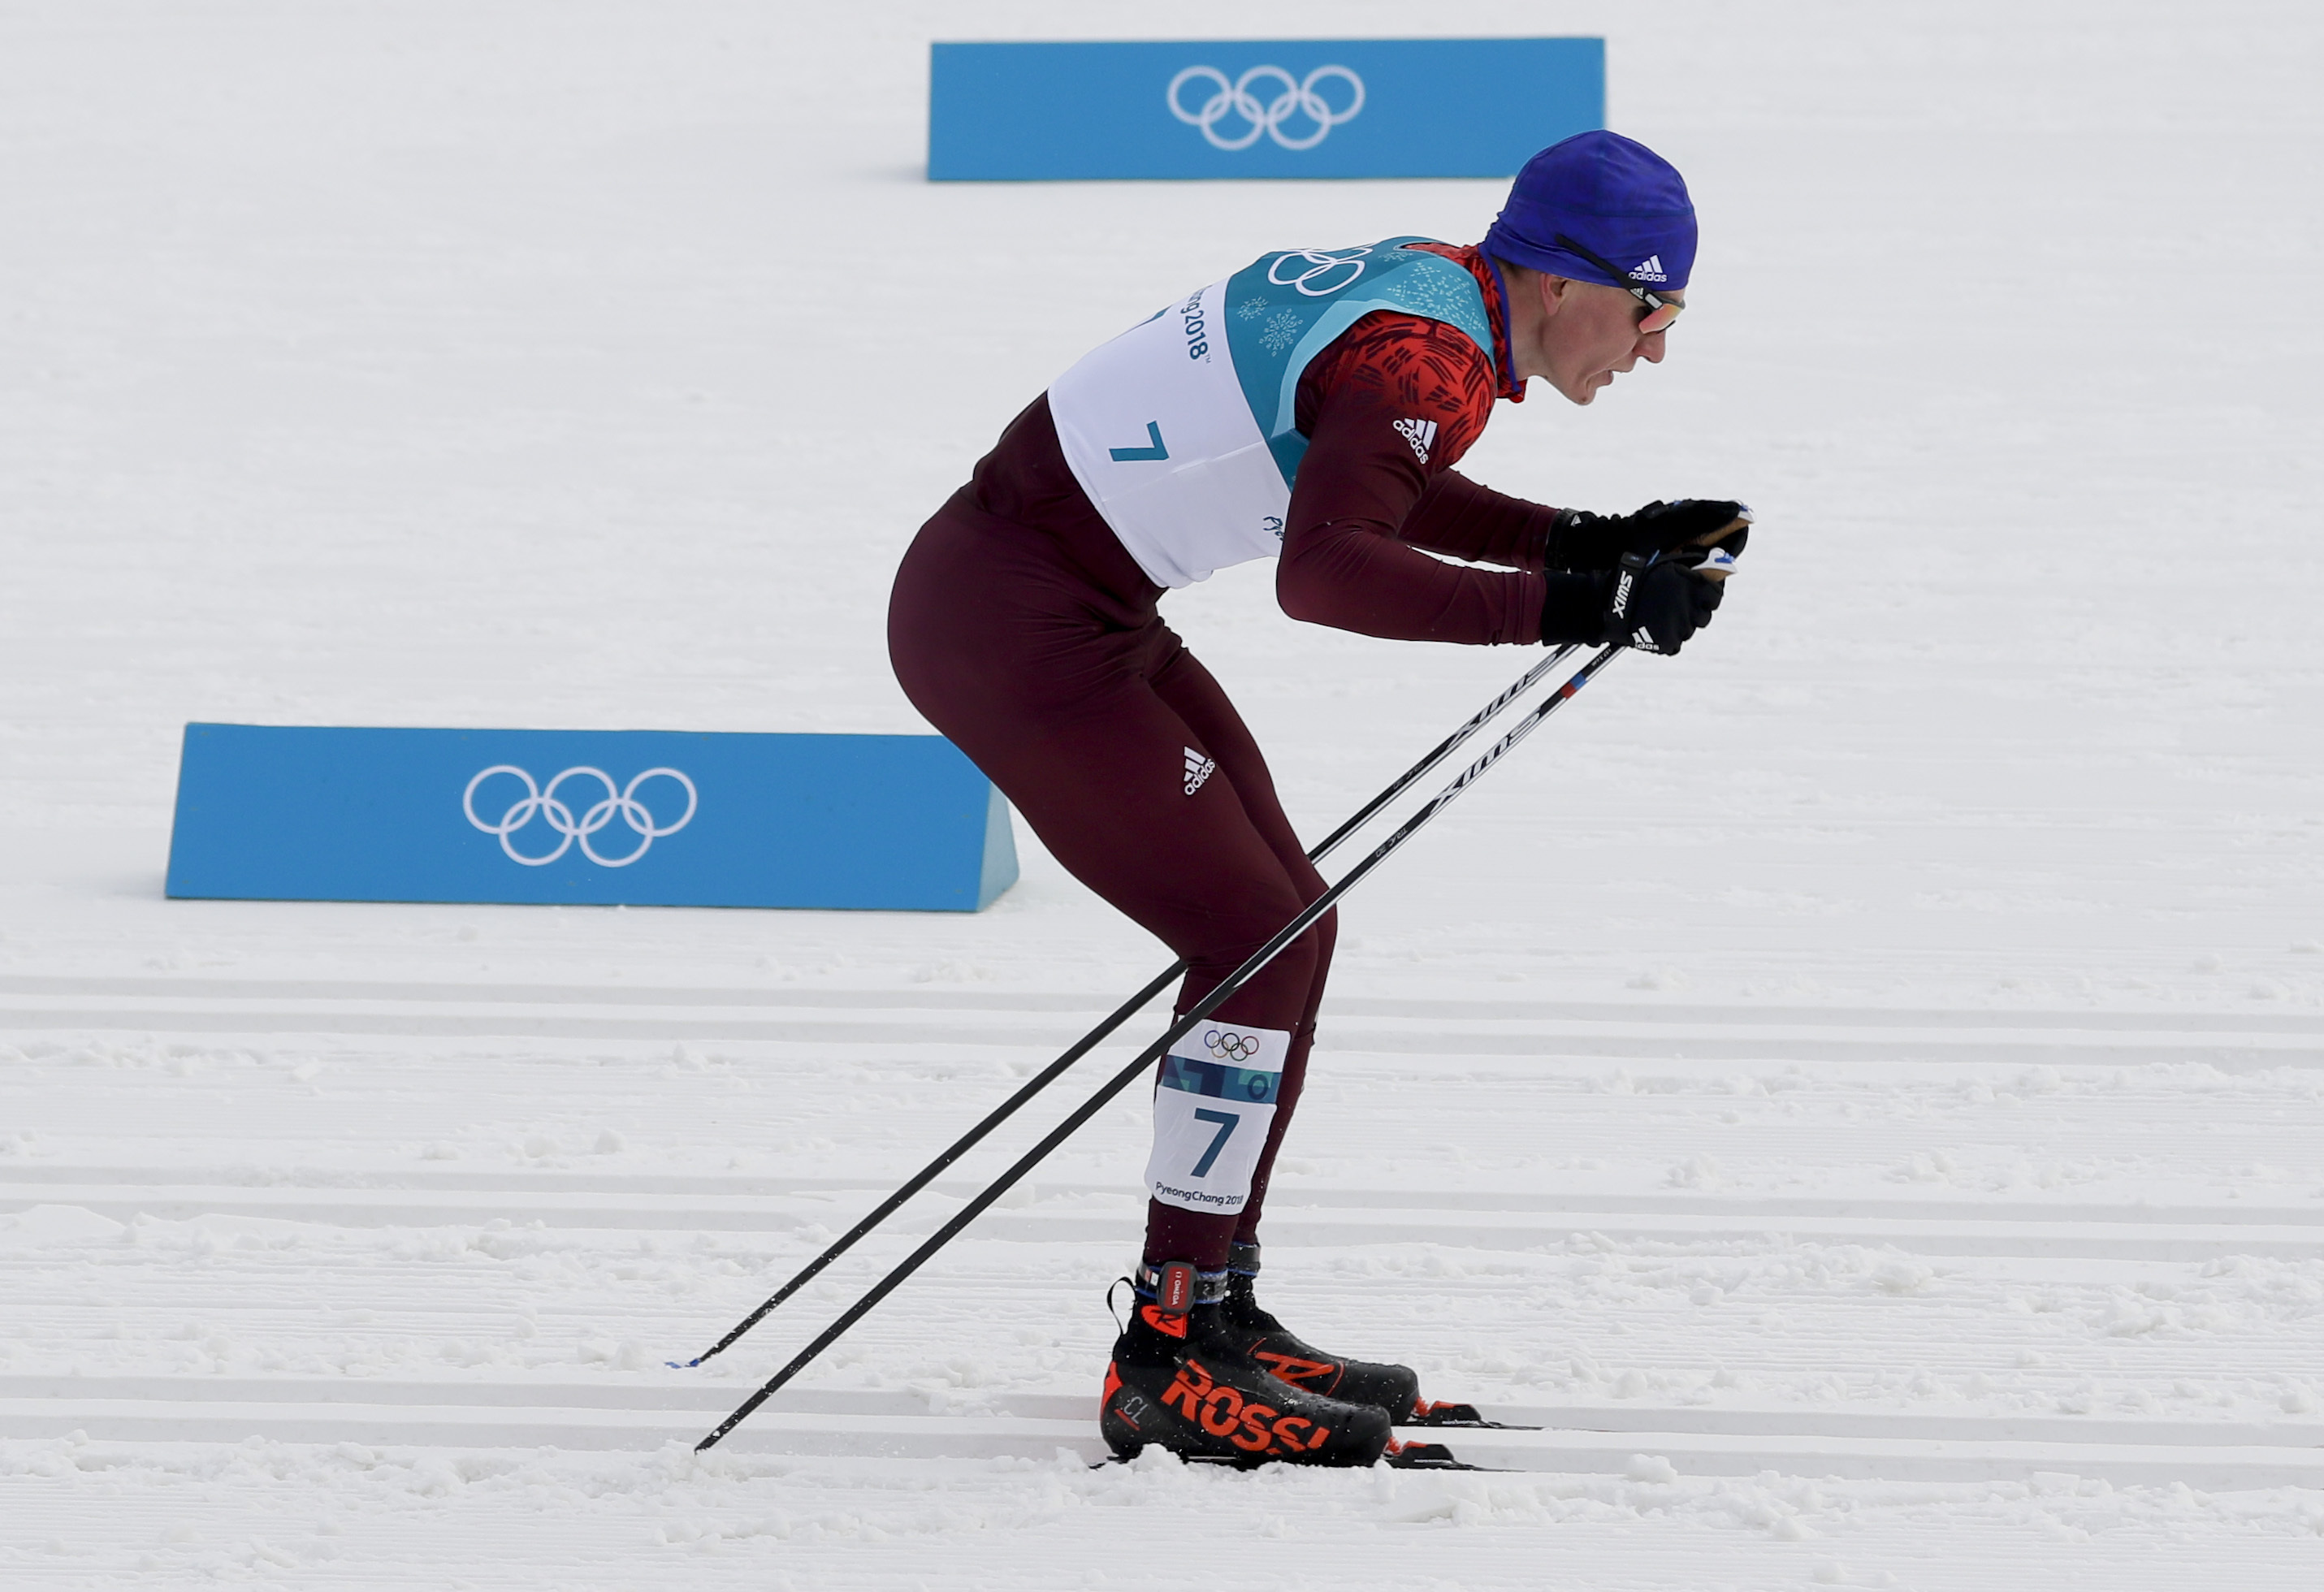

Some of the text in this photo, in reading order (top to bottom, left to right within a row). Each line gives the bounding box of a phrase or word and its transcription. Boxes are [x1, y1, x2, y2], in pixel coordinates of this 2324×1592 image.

[1629, 270, 1668, 282] adidas
[1109, 420, 1170, 462] 7
[1392, 419, 1429, 464] adidas
[1612, 570, 1634, 619] SWIX
[1184, 758, 1216, 796] adidas
[1429, 705, 1542, 815] SWIX
[1189, 1107, 1240, 1178] 7
[1155, 1181, 1225, 1206] PyeongChang
[1171, 1279, 1183, 1306] OMEGA
[1160, 1358, 1331, 1455] ROSSI
